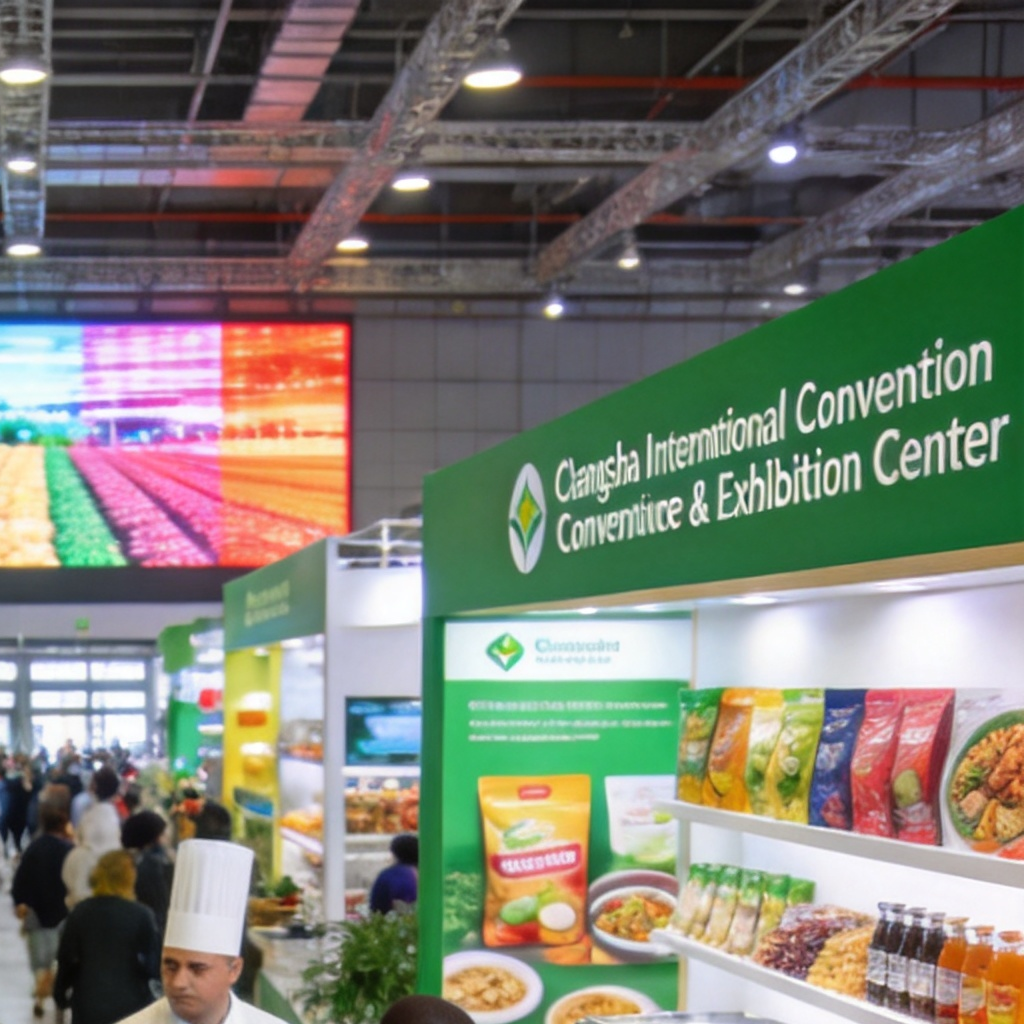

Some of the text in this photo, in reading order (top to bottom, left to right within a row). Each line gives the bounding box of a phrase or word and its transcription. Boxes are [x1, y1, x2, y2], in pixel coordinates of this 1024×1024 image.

[796, 338, 993, 434] Convention
[689, 480, 710, 527] &
[873, 414, 1010, 486] Center
